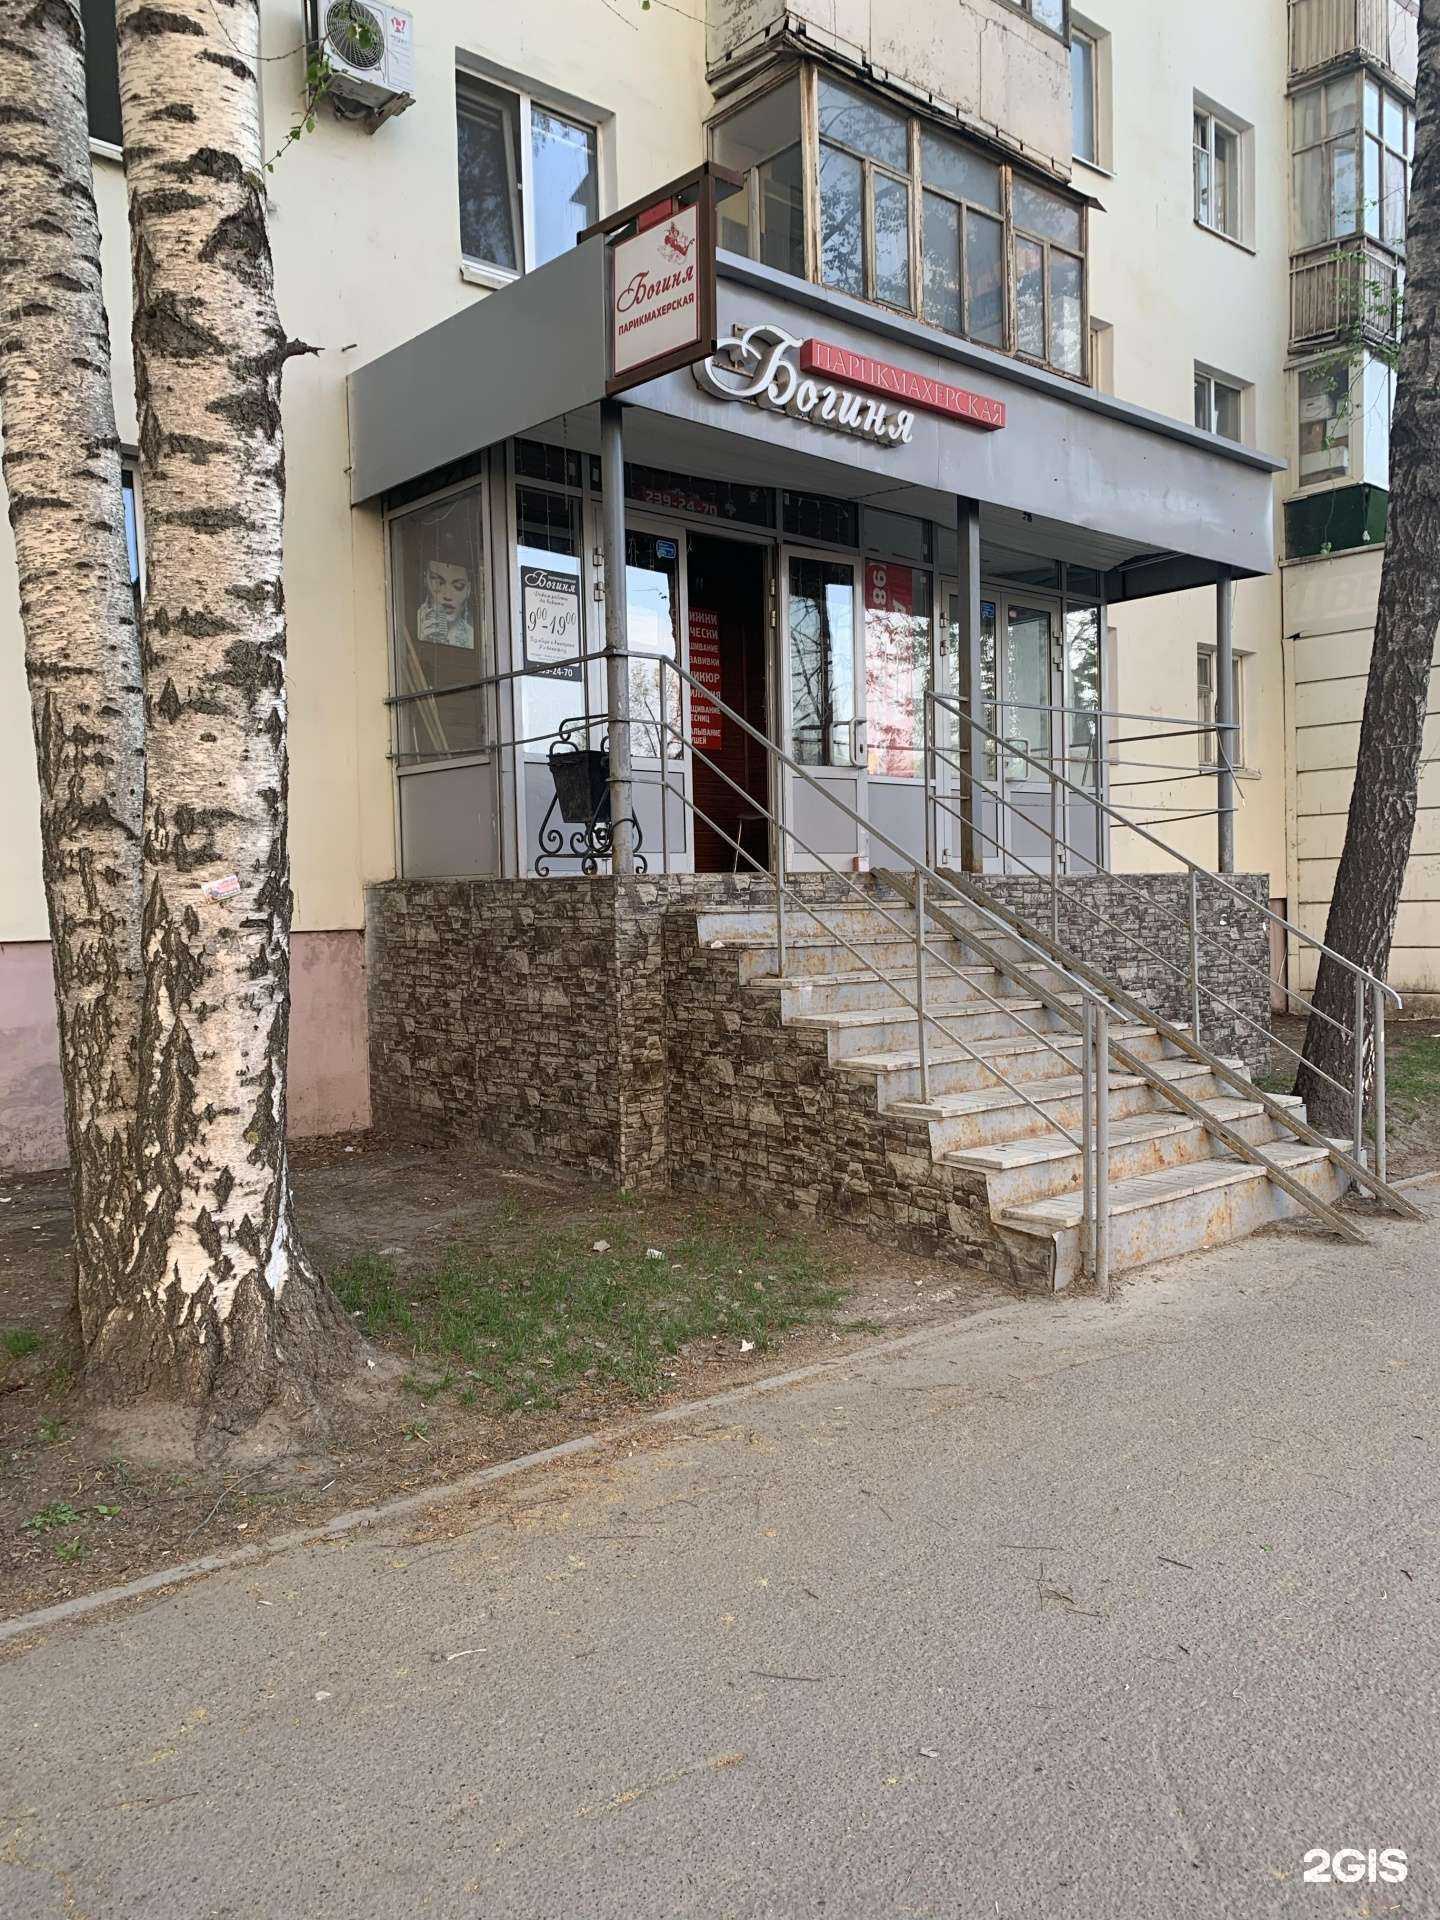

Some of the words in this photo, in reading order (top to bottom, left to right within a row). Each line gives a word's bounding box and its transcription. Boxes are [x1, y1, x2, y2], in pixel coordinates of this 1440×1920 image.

[617, 265, 694, 312] Богиня
[618, 293, 694, 335] ПАРИКМАХЕРСКАЯ
[704, 324, 914, 443] Богиня
[815, 343, 1003, 424] ПАРИКМАХЕРСКАЯ
[645, 490, 718, 517] 239-24-70
[525, 570, 576, 593] Богиня
